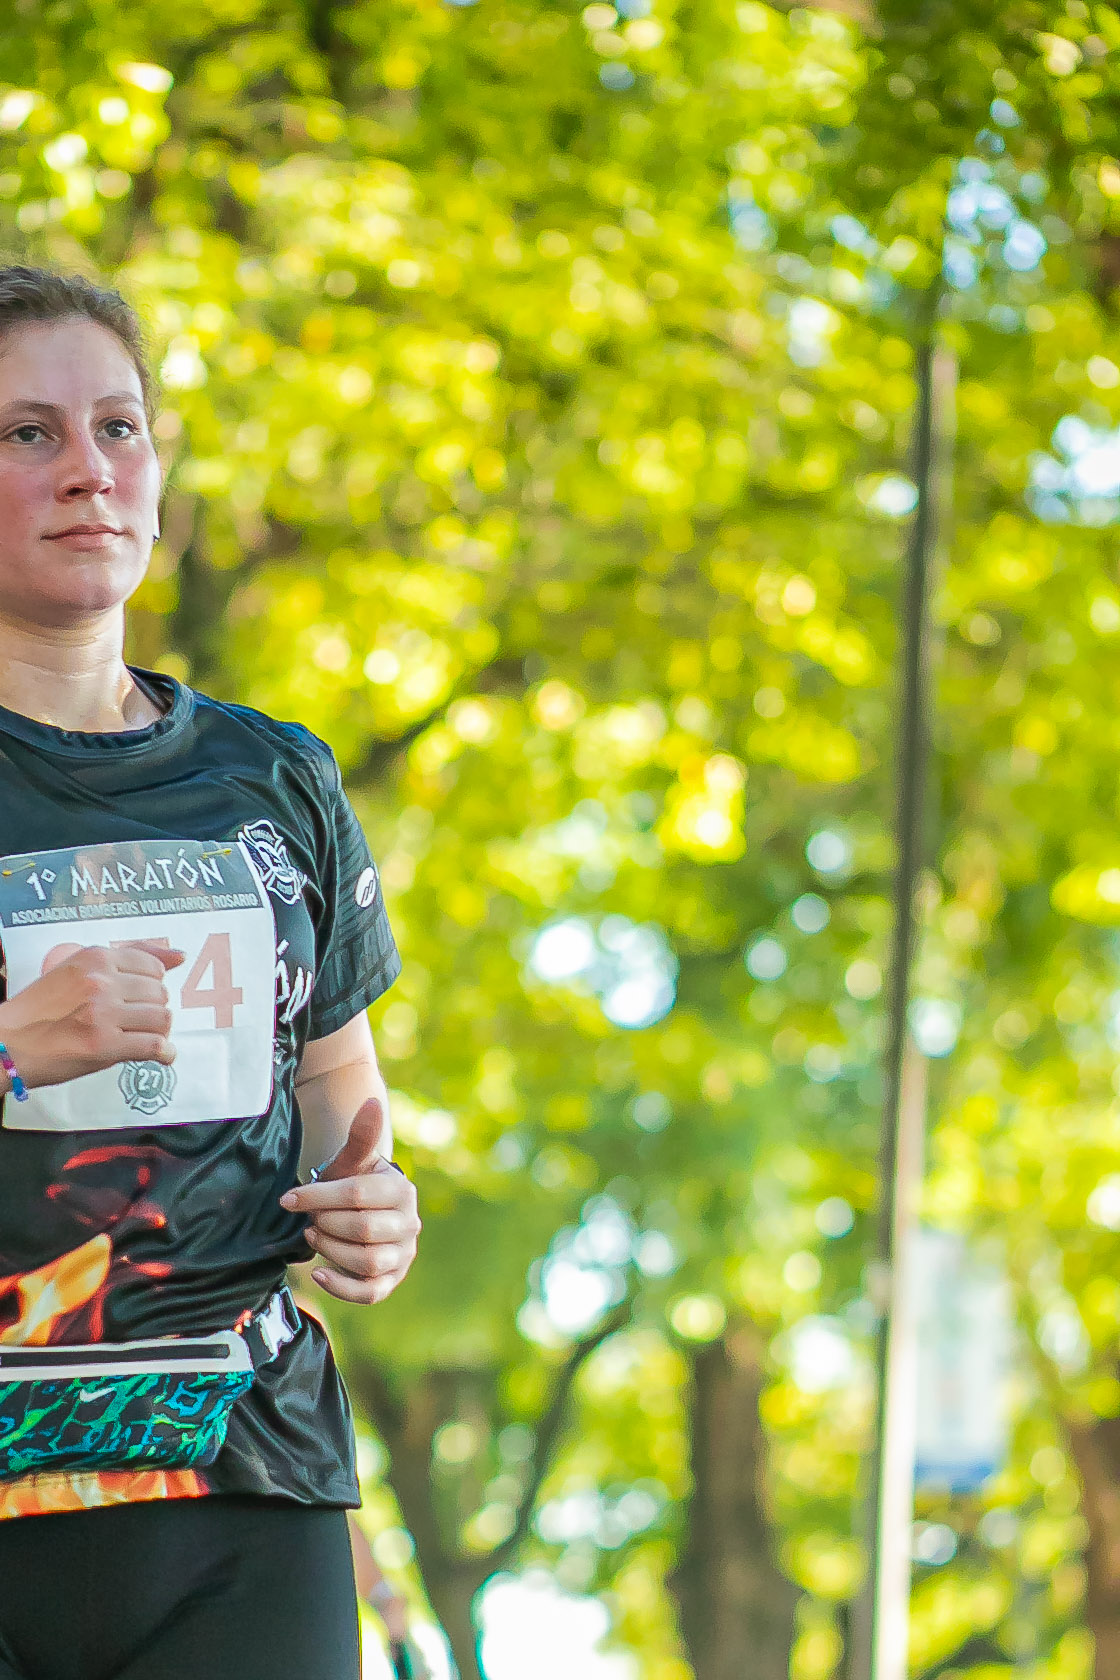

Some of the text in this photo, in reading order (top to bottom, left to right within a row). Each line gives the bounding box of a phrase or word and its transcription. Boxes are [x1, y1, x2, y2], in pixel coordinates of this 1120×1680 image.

[71, 848, 225, 897] MARATÓN
[79, 900, 138, 919] BOMBEROS
[141, 895, 212, 914] VOLUNTARIOS
[213, 892, 259, 909] ROSARIO
[138, 1068, 162, 1091] 27
